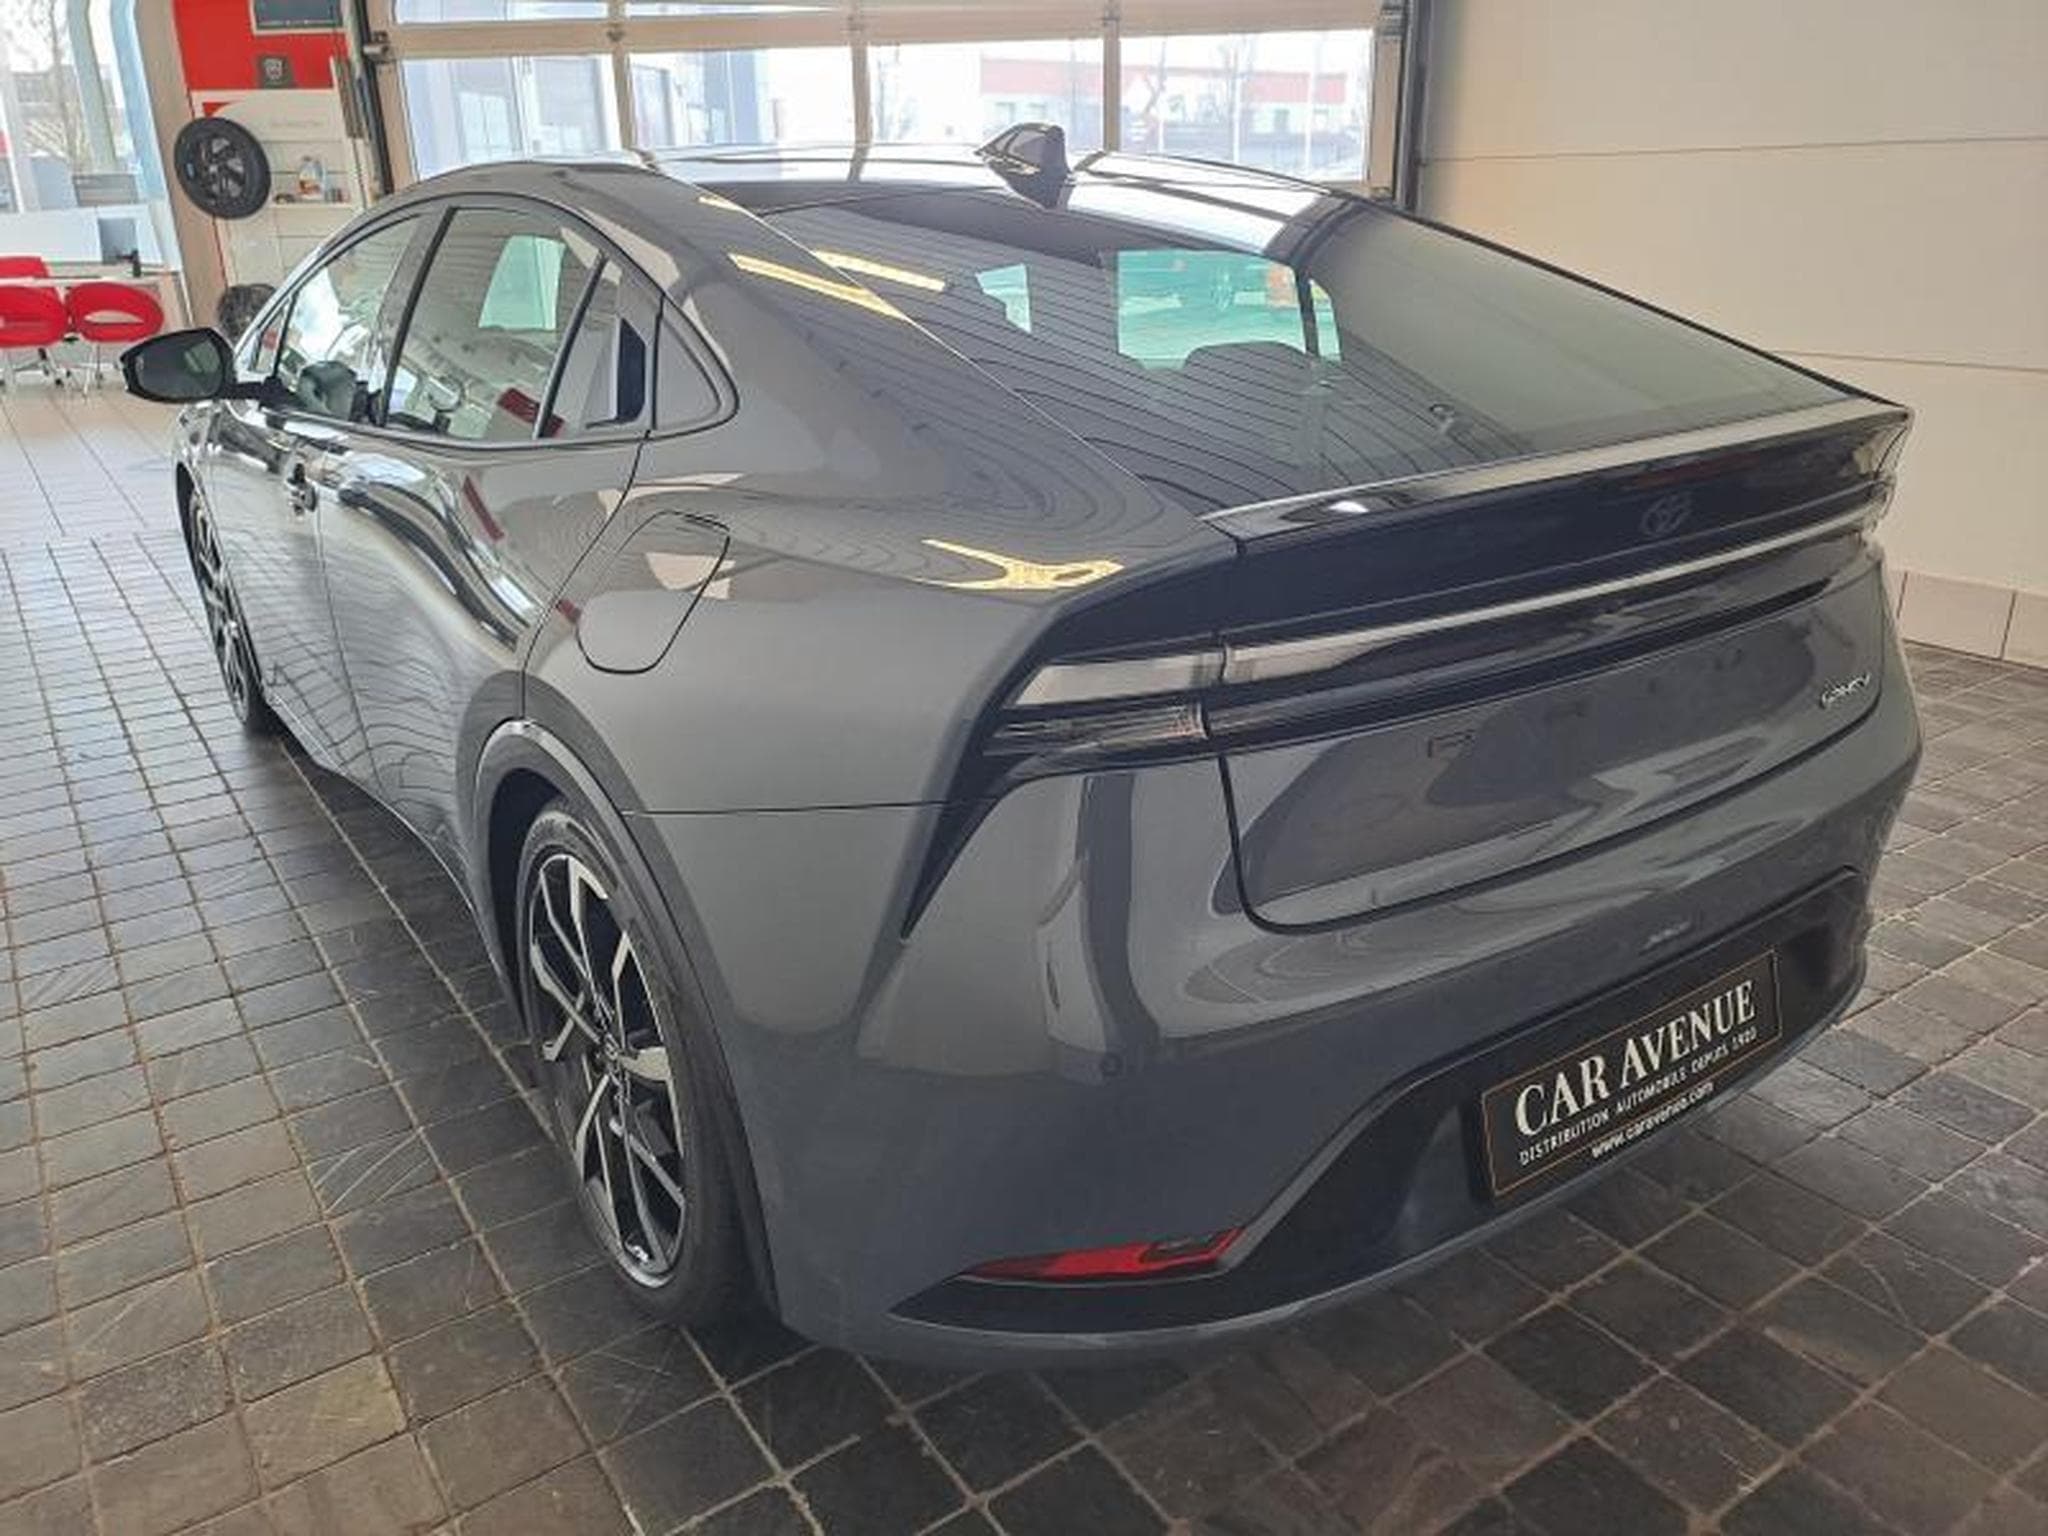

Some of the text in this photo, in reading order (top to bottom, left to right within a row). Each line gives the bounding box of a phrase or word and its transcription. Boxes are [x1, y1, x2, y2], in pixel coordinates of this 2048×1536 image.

[1515, 980, 1755, 1136] CAR AVENUE
[1519, 1108, 1609, 1166] DISTRIBUTION
